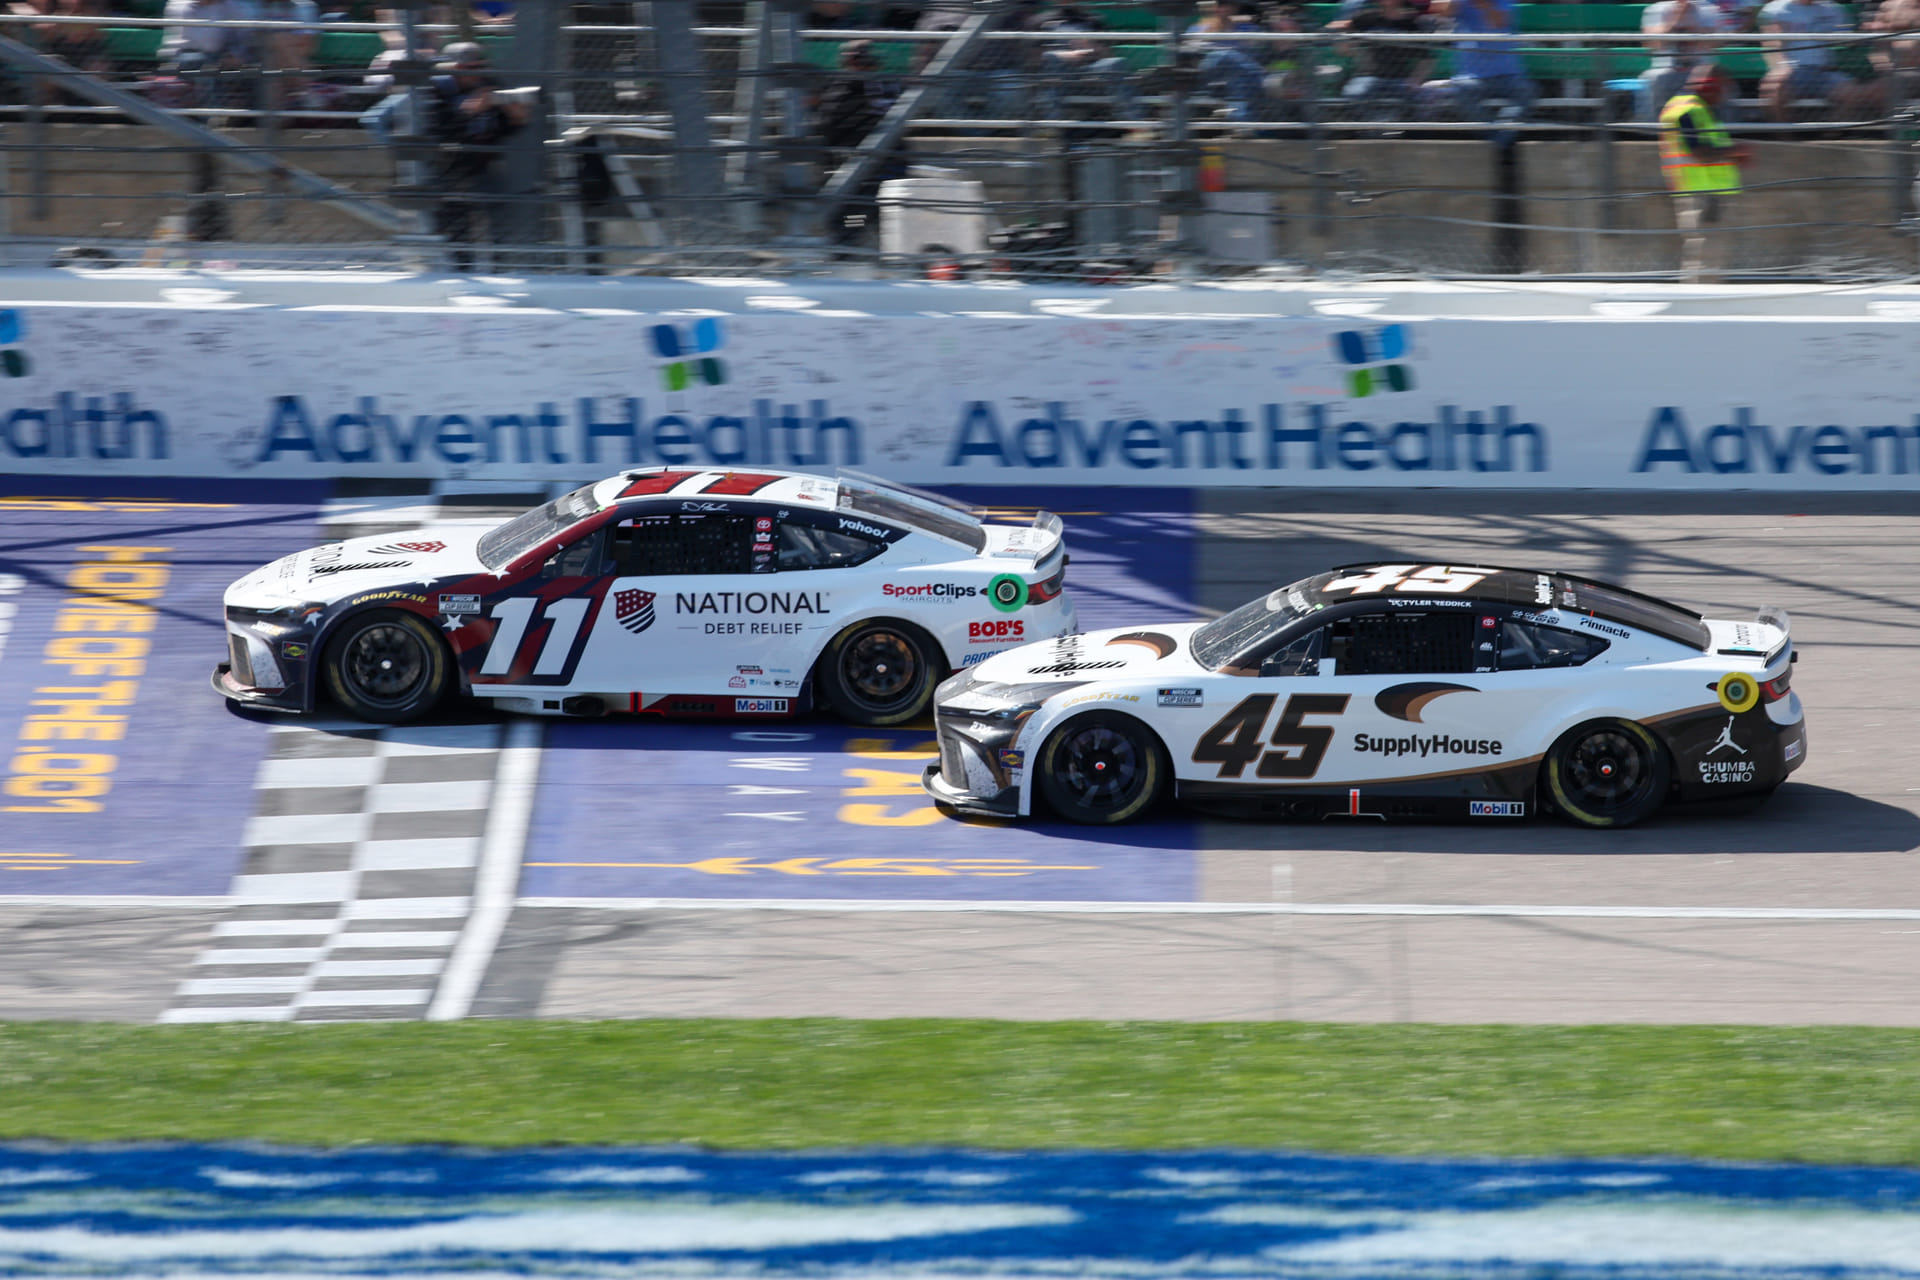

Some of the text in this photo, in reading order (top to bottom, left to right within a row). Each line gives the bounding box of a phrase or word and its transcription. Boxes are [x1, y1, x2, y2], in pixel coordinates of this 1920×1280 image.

[0, 391, 172, 460] alth
[257, 394, 863, 467] AdventHealth
[946, 399, 1550, 474] AdventHealth
[837, 517, 891, 539] yahoo!
[50, 545, 176, 633] HOME
[1322, 565, 1503, 594] 45
[352, 590, 427, 606] GOODYEAR
[882, 583, 976, 599] SportClips
[676, 592, 831, 614] NATIONAL
[480, 597, 592, 675] 11
[704, 623, 804, 635] DEBT RELIEF
[969, 620, 1024, 637] BOB'S
[1580, 617, 1632, 639] Pinnacle
[42, 636, 153, 677] OF
[17, 680, 142, 741] THE
[737, 700, 786, 712] Mobil 1
[1062, 692, 1140, 708] GOODYEAR
[1176, 696, 1196, 704] SERIES
[1191, 693, 1352, 780] 45
[1354, 733, 1502, 757] SupplyHouse
[1698, 761, 1755, 773] CHUMBA
[1702, 772, 1753, 783] CASINO
[1471, 802, 1522, 815] Mobil 1
